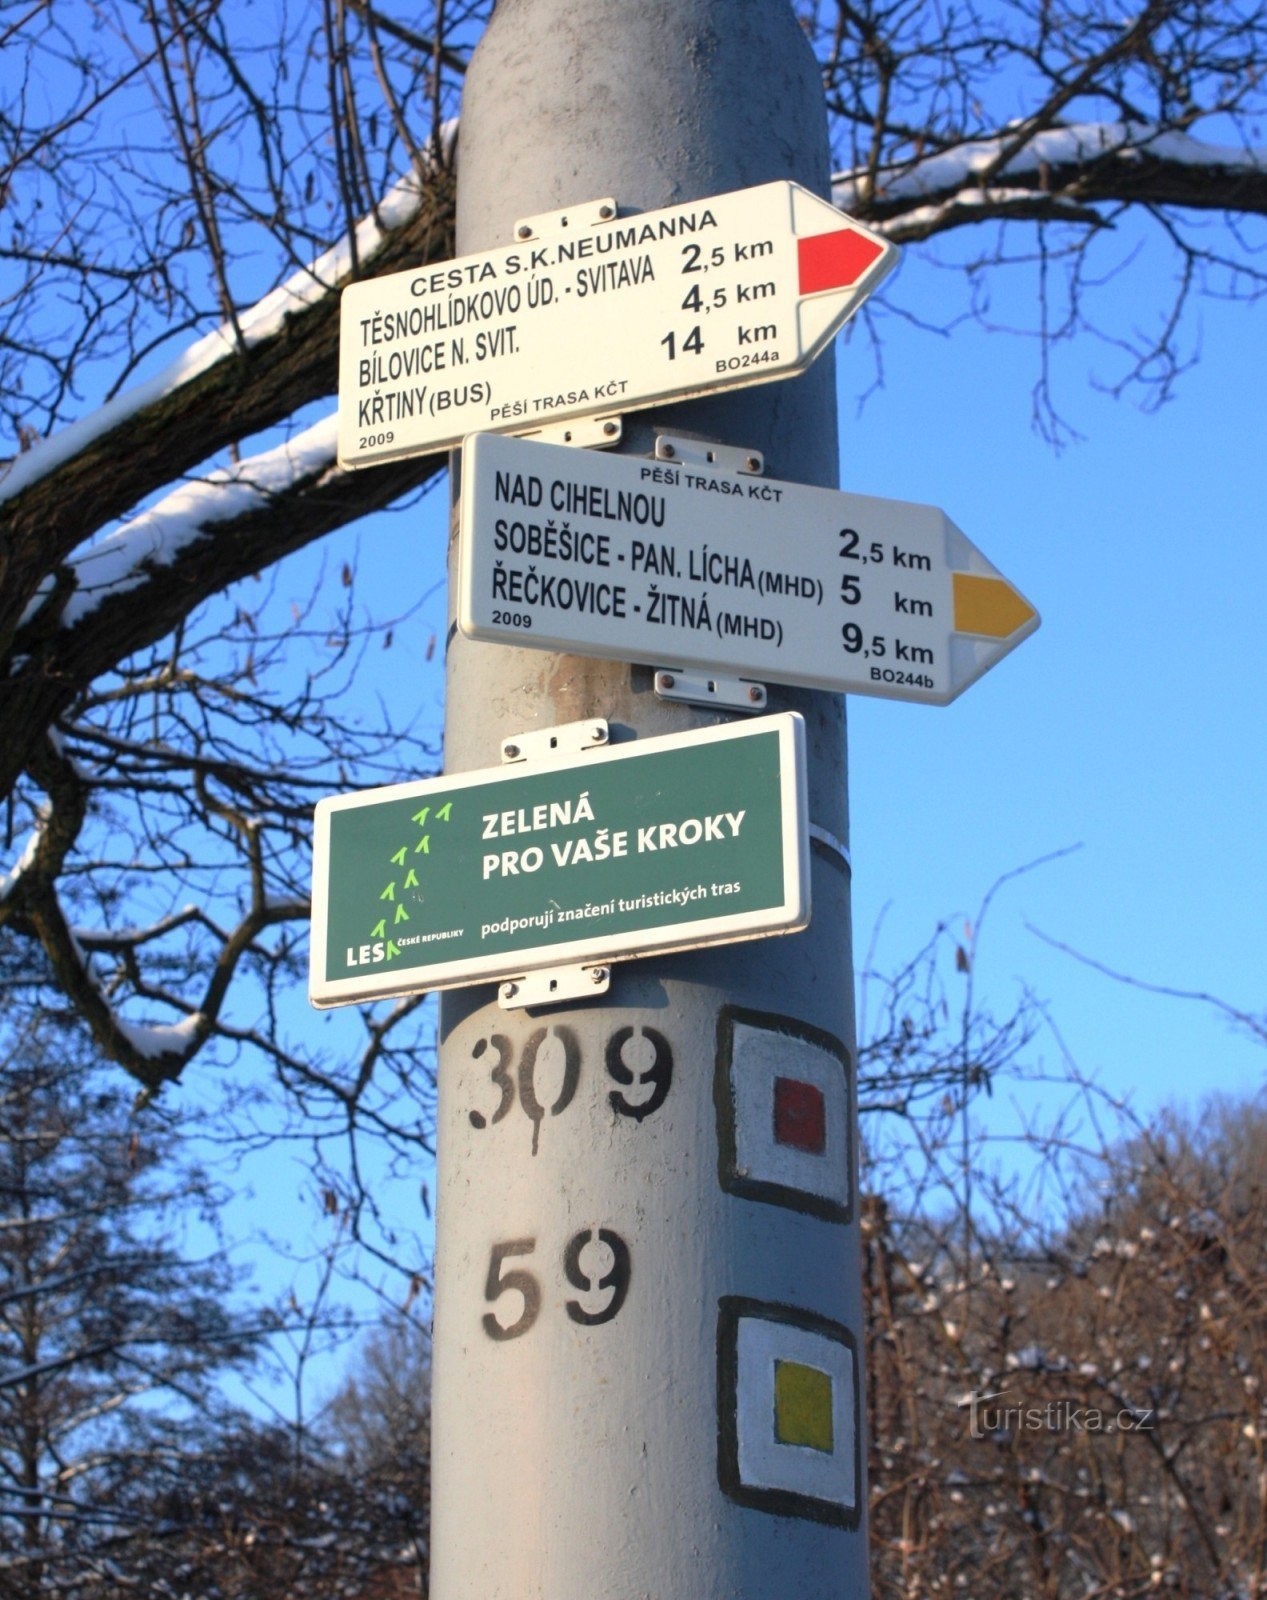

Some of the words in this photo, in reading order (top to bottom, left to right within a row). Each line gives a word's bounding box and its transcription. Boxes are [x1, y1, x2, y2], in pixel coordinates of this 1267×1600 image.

[360, 287, 521, 347] TĚSNOHLÍDKOVO
[527, 275, 559, 309] ÚD.
[576, 254, 656, 298] SVITAVA
[681, 243, 725, 274] 2,5
[734, 239, 774, 262] km
[410, 264, 496, 297] CESTA
[359, 338, 446, 388] BÍLOVICE
[452, 337, 471, 367] N.
[475, 325, 520, 361] SVIT.
[681, 284, 727, 315] 4,5
[736, 280, 776, 303] km
[661, 325, 705, 361] 14
[738, 323, 777, 346] km
[716, 351, 779, 373] BO244a
[490, 402, 528, 421] PĚŠÍ
[533, 391, 589, 411] TRASA
[594, 379, 628, 399] KČT
[359, 431, 394, 449] 2009
[494, 470, 543, 508] NAD
[550, 479, 666, 528] CIHELNOU
[640, 467, 680, 486] PĚŠÍ
[684, 474, 743, 497] TRASA
[748, 484, 783, 503] KČT
[493, 518, 611, 568] SOBĚŠICE
[631, 539, 683, 579] PAN.
[838, 527, 884, 565] 2,5
[892, 545, 932, 572] km
[492, 559, 627, 619] ŘEČKOVICE
[840, 573, 862, 606] 5
[894, 591, 933, 618] km
[491, 609, 533, 629] 2009
[841, 622, 887, 659] 9,5
[894, 638, 934, 665] km
[870, 666, 935, 689] BO244b
[481, 790, 596, 840] ZELENÁ
[482, 846, 544, 880] PRO
[550, 827, 628, 868] VAŠE
[637, 809, 747, 854] KROKY
[481, 907, 554, 940] podporují
[556, 898, 615, 926] značení
[617, 884, 706, 914] turistických
[710, 881, 742, 899] tras
[422, 928, 464, 943] REPUBLIKY
[482, 1228, 632, 1342] 59
